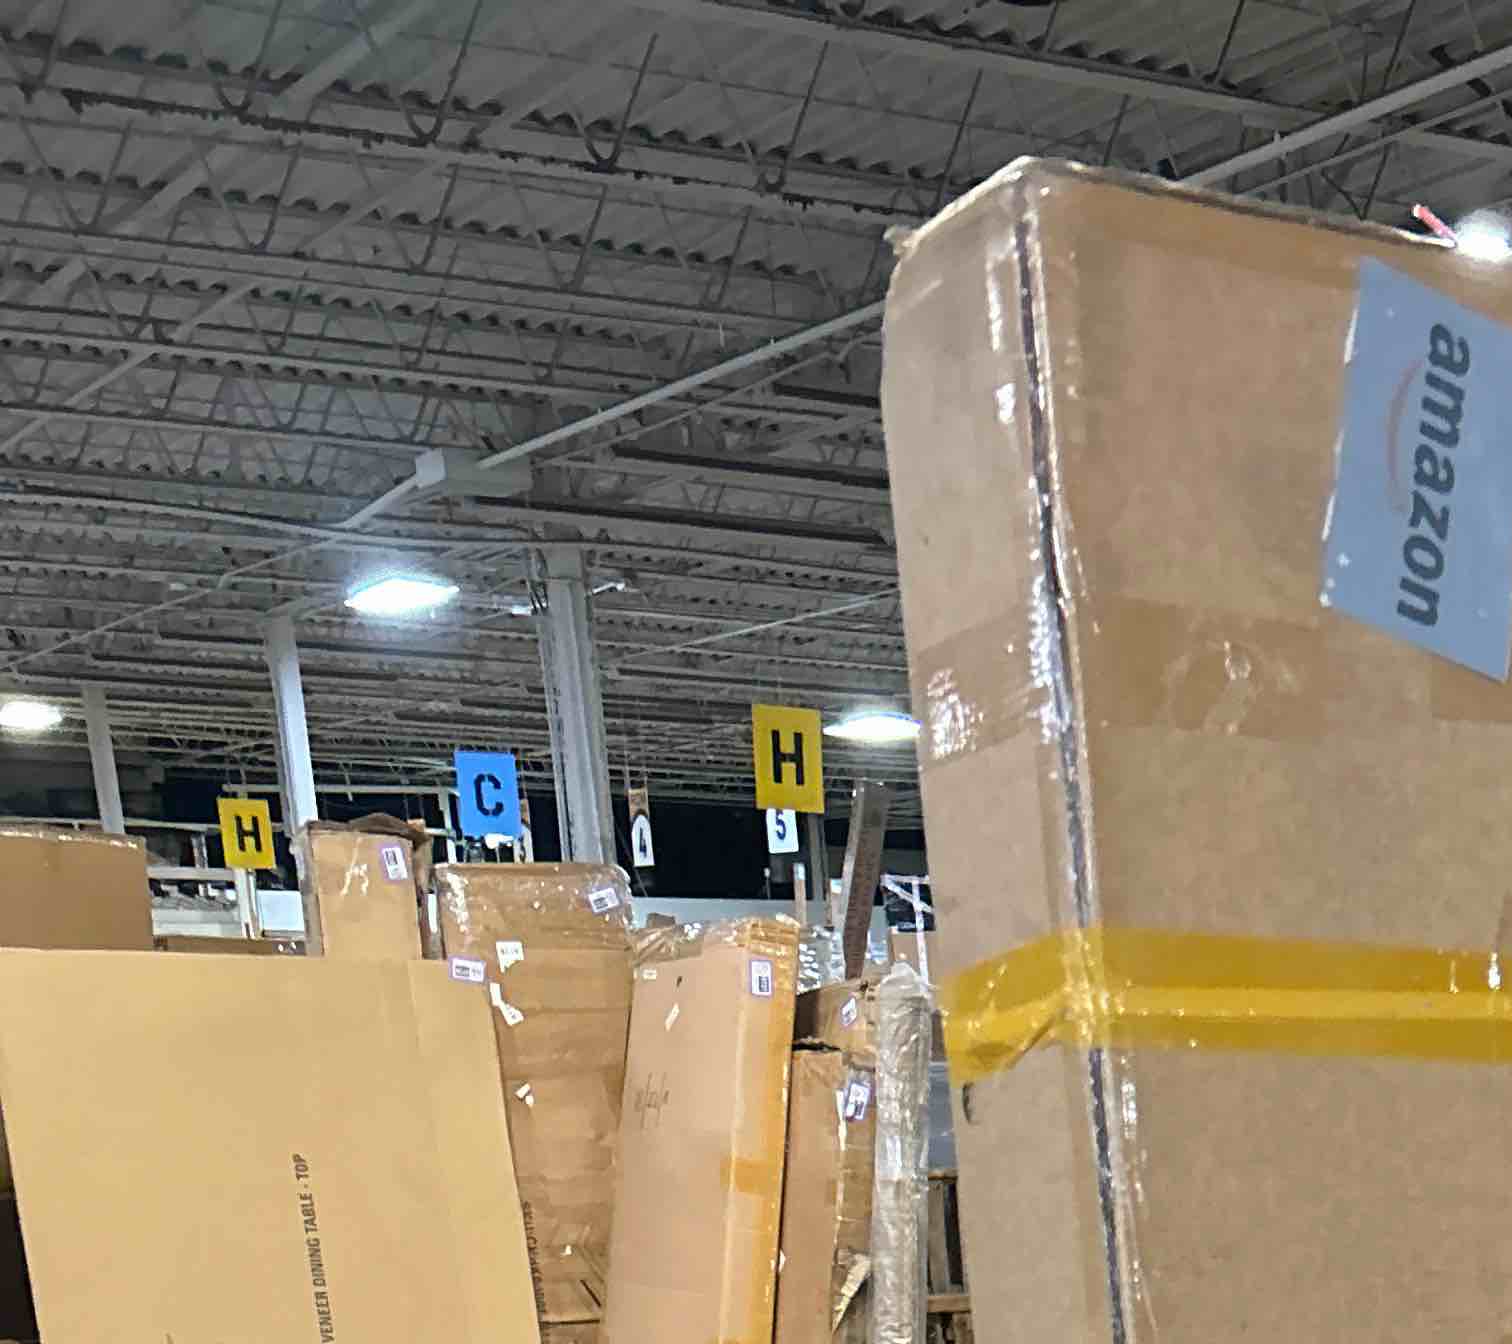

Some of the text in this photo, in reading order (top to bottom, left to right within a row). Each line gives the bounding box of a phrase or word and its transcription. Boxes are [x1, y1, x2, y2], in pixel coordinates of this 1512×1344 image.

[1396, 323, 1471, 628] amazon
[772, 729, 804, 785] H
[475, 774, 504, 817] C
[237, 816, 260, 851] H
[639, 834, 648, 857] 4
[775, 810, 787, 839] 5
[292, 1152, 309, 1180] TOP
[298, 1192, 318, 1233] TABLE
[305, 1237, 326, 1287] DINING
[313, 1290, 335, 1343] VENEER
